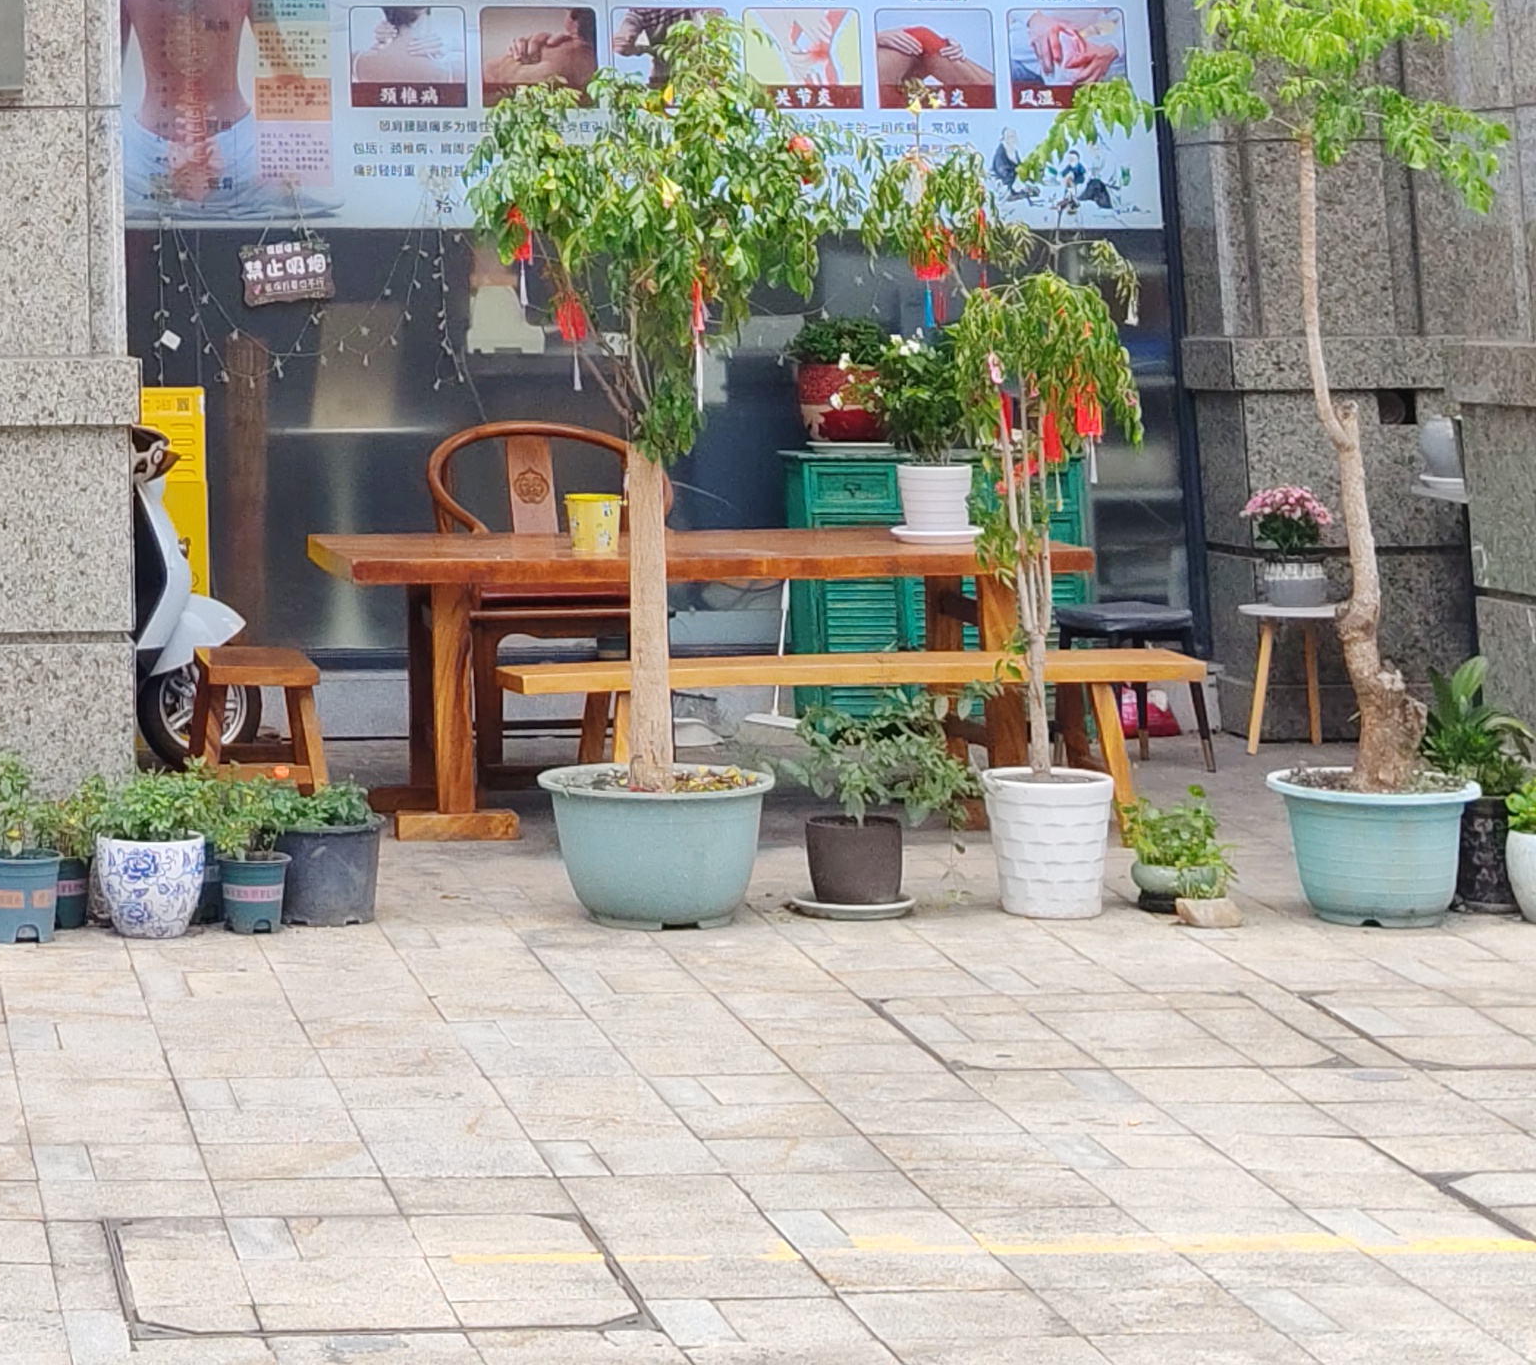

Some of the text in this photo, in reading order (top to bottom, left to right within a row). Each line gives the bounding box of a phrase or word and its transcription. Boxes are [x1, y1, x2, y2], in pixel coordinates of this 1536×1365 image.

[378, 85, 440, 106] 颈椎病
[774, 86, 835, 107] 关节炎
[244, 252, 327, 282] 禁止吸烟
